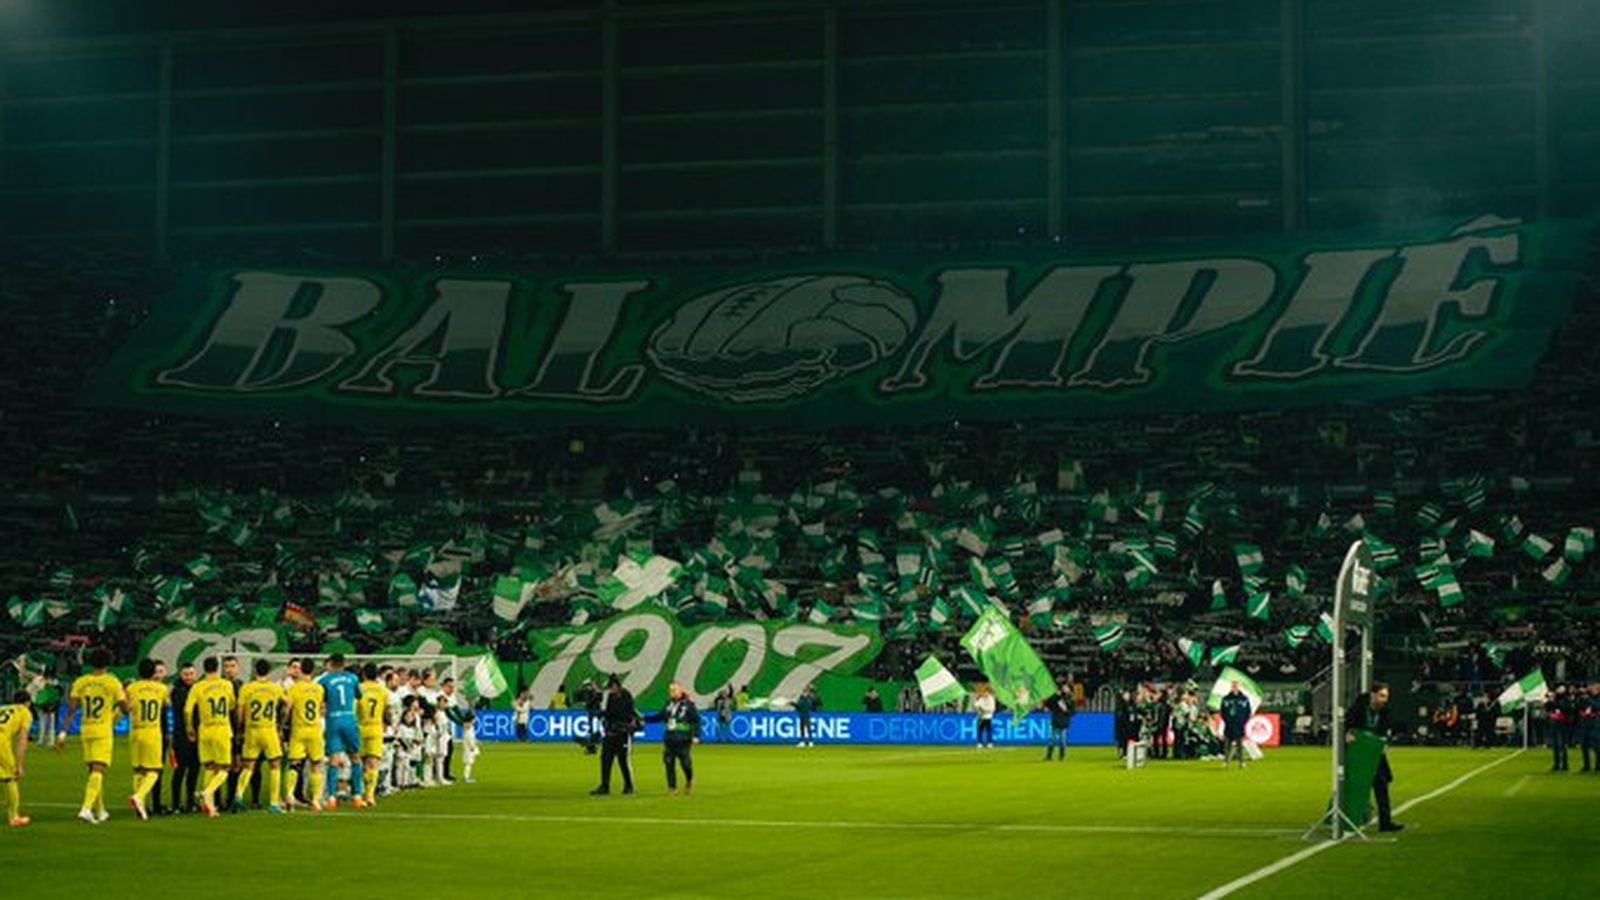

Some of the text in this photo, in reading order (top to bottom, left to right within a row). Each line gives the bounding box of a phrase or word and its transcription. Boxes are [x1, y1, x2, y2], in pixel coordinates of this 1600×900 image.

[528, 613, 871, 708] 1907
[337, 684, 346, 706] 1
[85, 697, 104, 719] 12
[140, 699, 159, 722] 10
[207, 697, 226, 718] 14
[250, 700, 274, 722] 24
[305, 700, 317, 721] 8
[367, 699, 378, 718] 7
[700, 716, 850, 739] ROHIGIENE
[868, 718, 1048, 741] DERMOHGIEN
